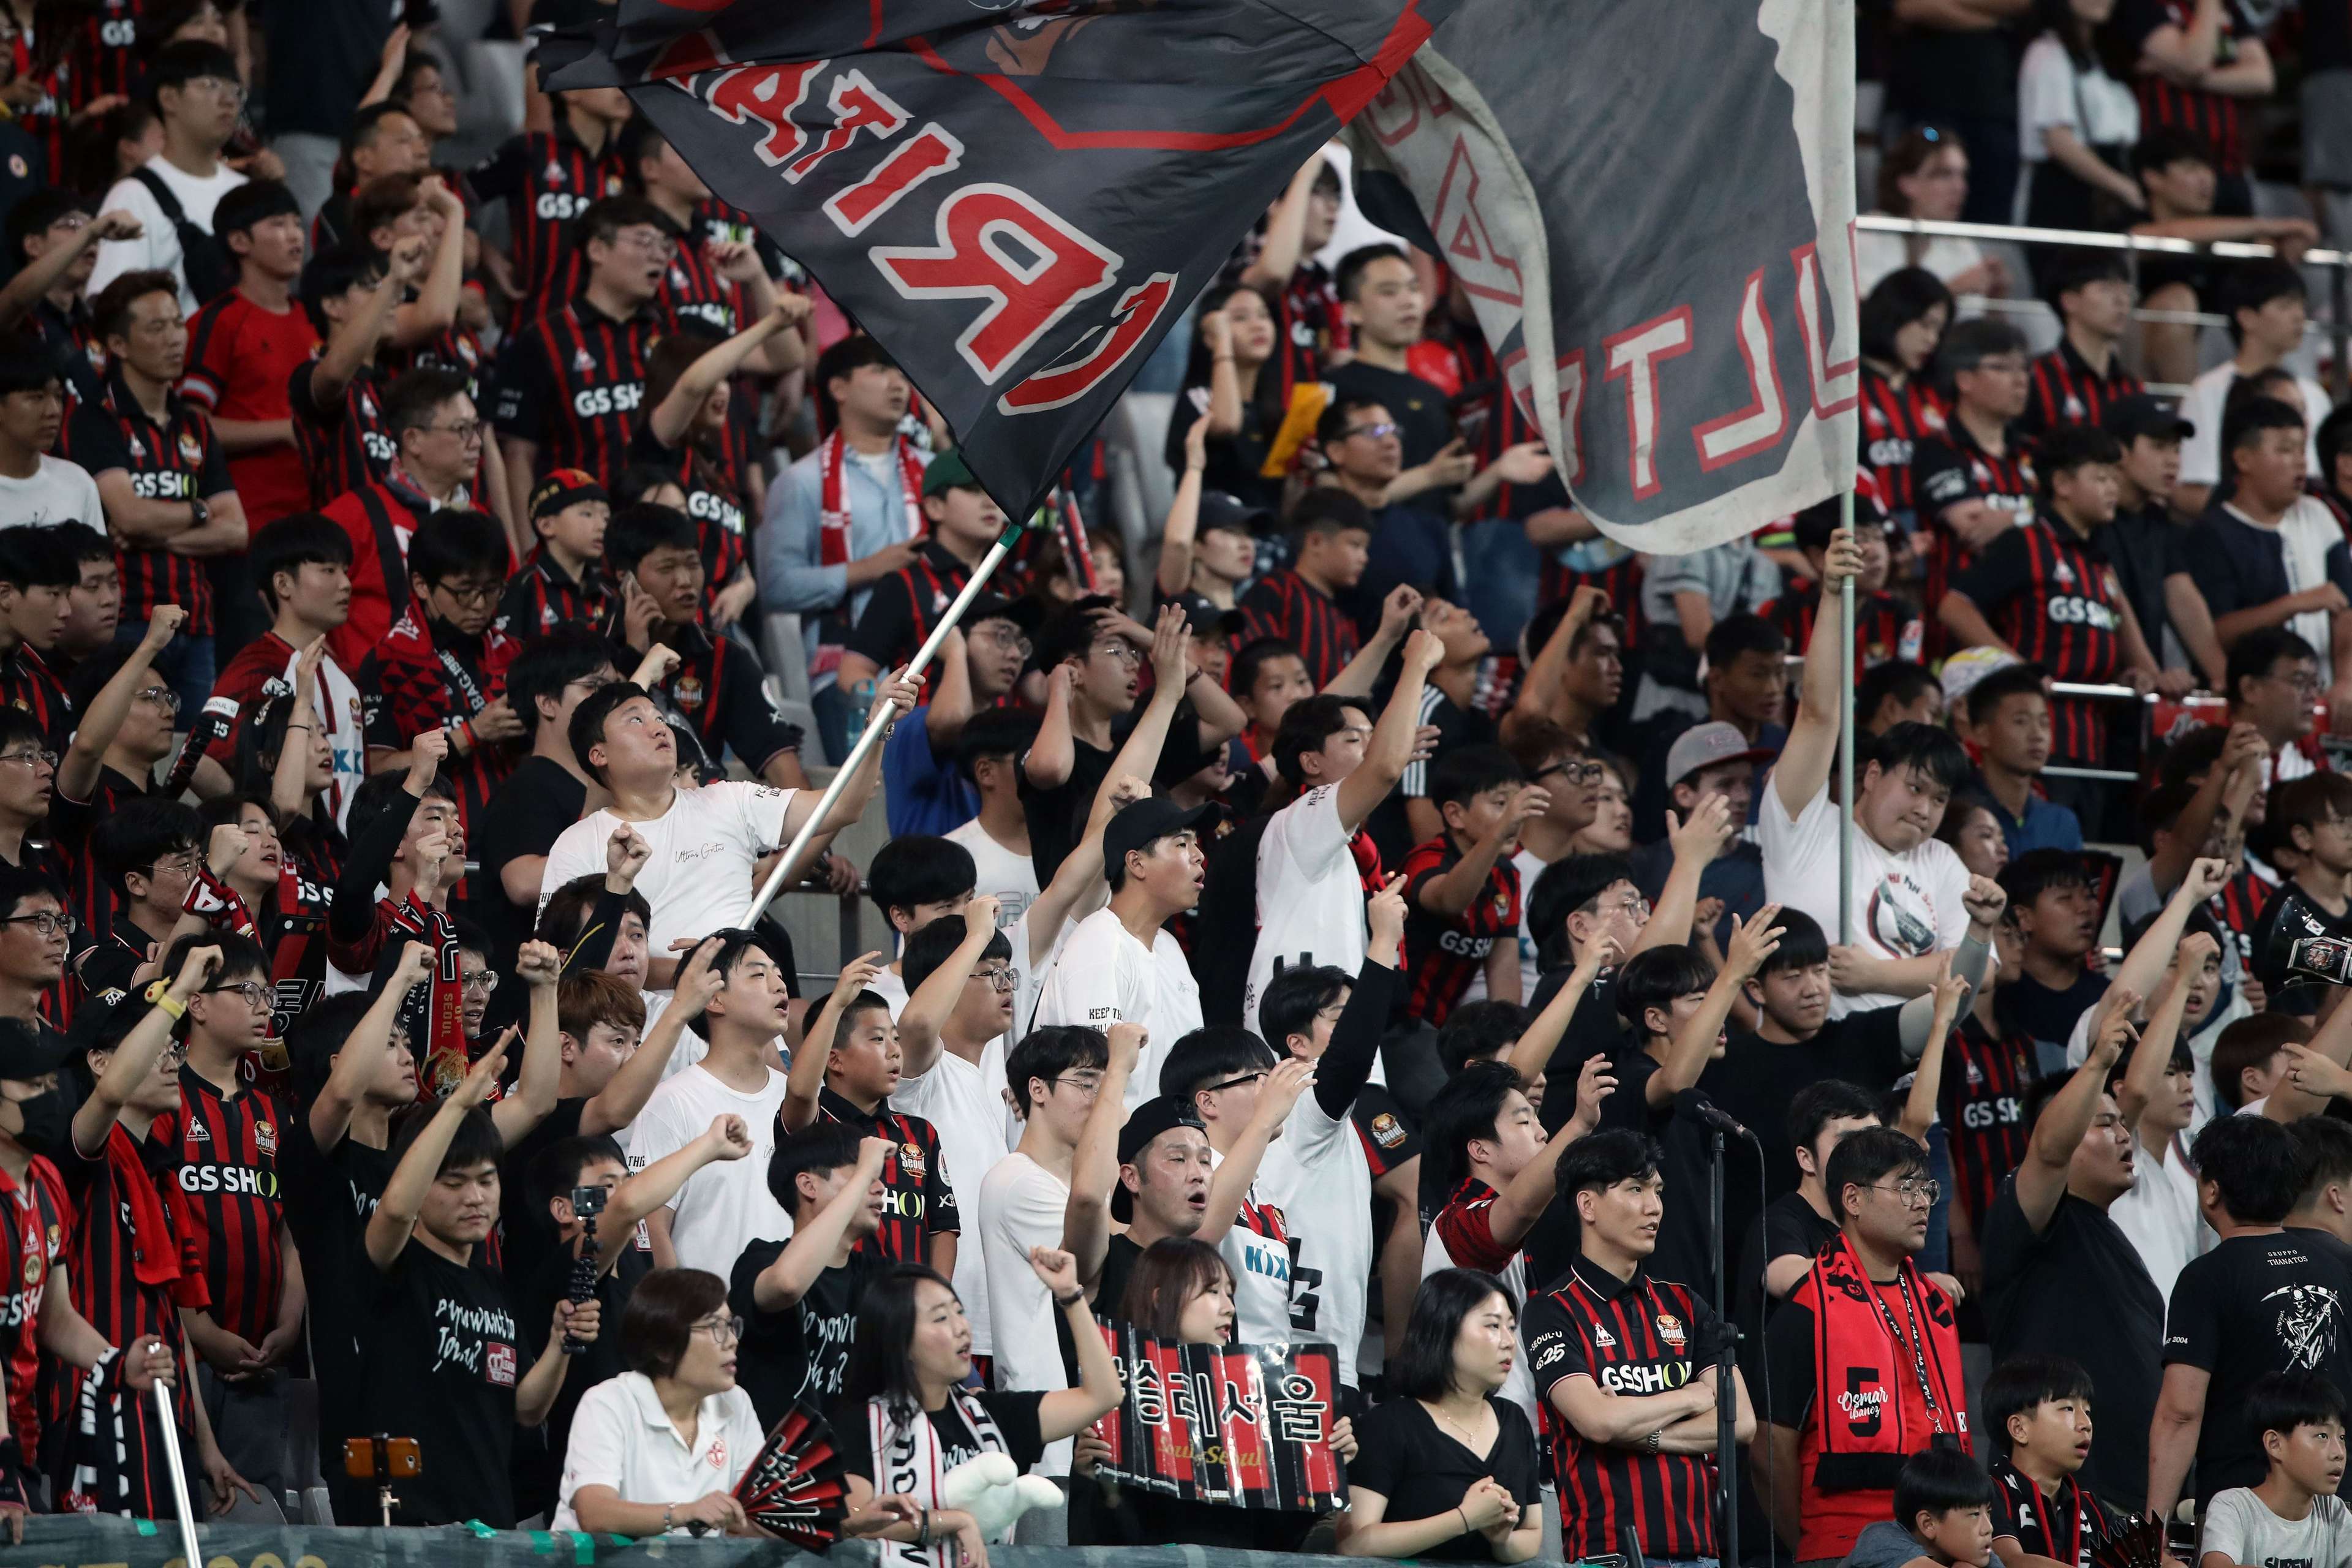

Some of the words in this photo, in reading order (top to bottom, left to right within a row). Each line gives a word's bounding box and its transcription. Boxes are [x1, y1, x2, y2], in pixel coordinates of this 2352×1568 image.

[1439, 929, 1472, 956] GS
[418, 975, 429, 1014] ORLD
[440, 992, 454, 1038] SEOUL
[1089, 1008, 1109, 1020] KEEP
[1112, 1008, 1122, 1020] TH
[1964, 1101, 1995, 1128] GS
[1373, 1121, 1406, 1145] Seoul
[898, 1152, 926, 1171] Seoul
[178, 1165, 219, 1193] GS
[222, 1166, 281, 1199] SHO
[2267, 1256, 2309, 1266] THANATOS
[1656, 1324, 1686, 1340] Seoul
[1112, 1357, 1327, 1442] 승리서울
[1838, 1386, 1888, 1411] Osmar
[1204, 1444, 1261, 1467] Seul
